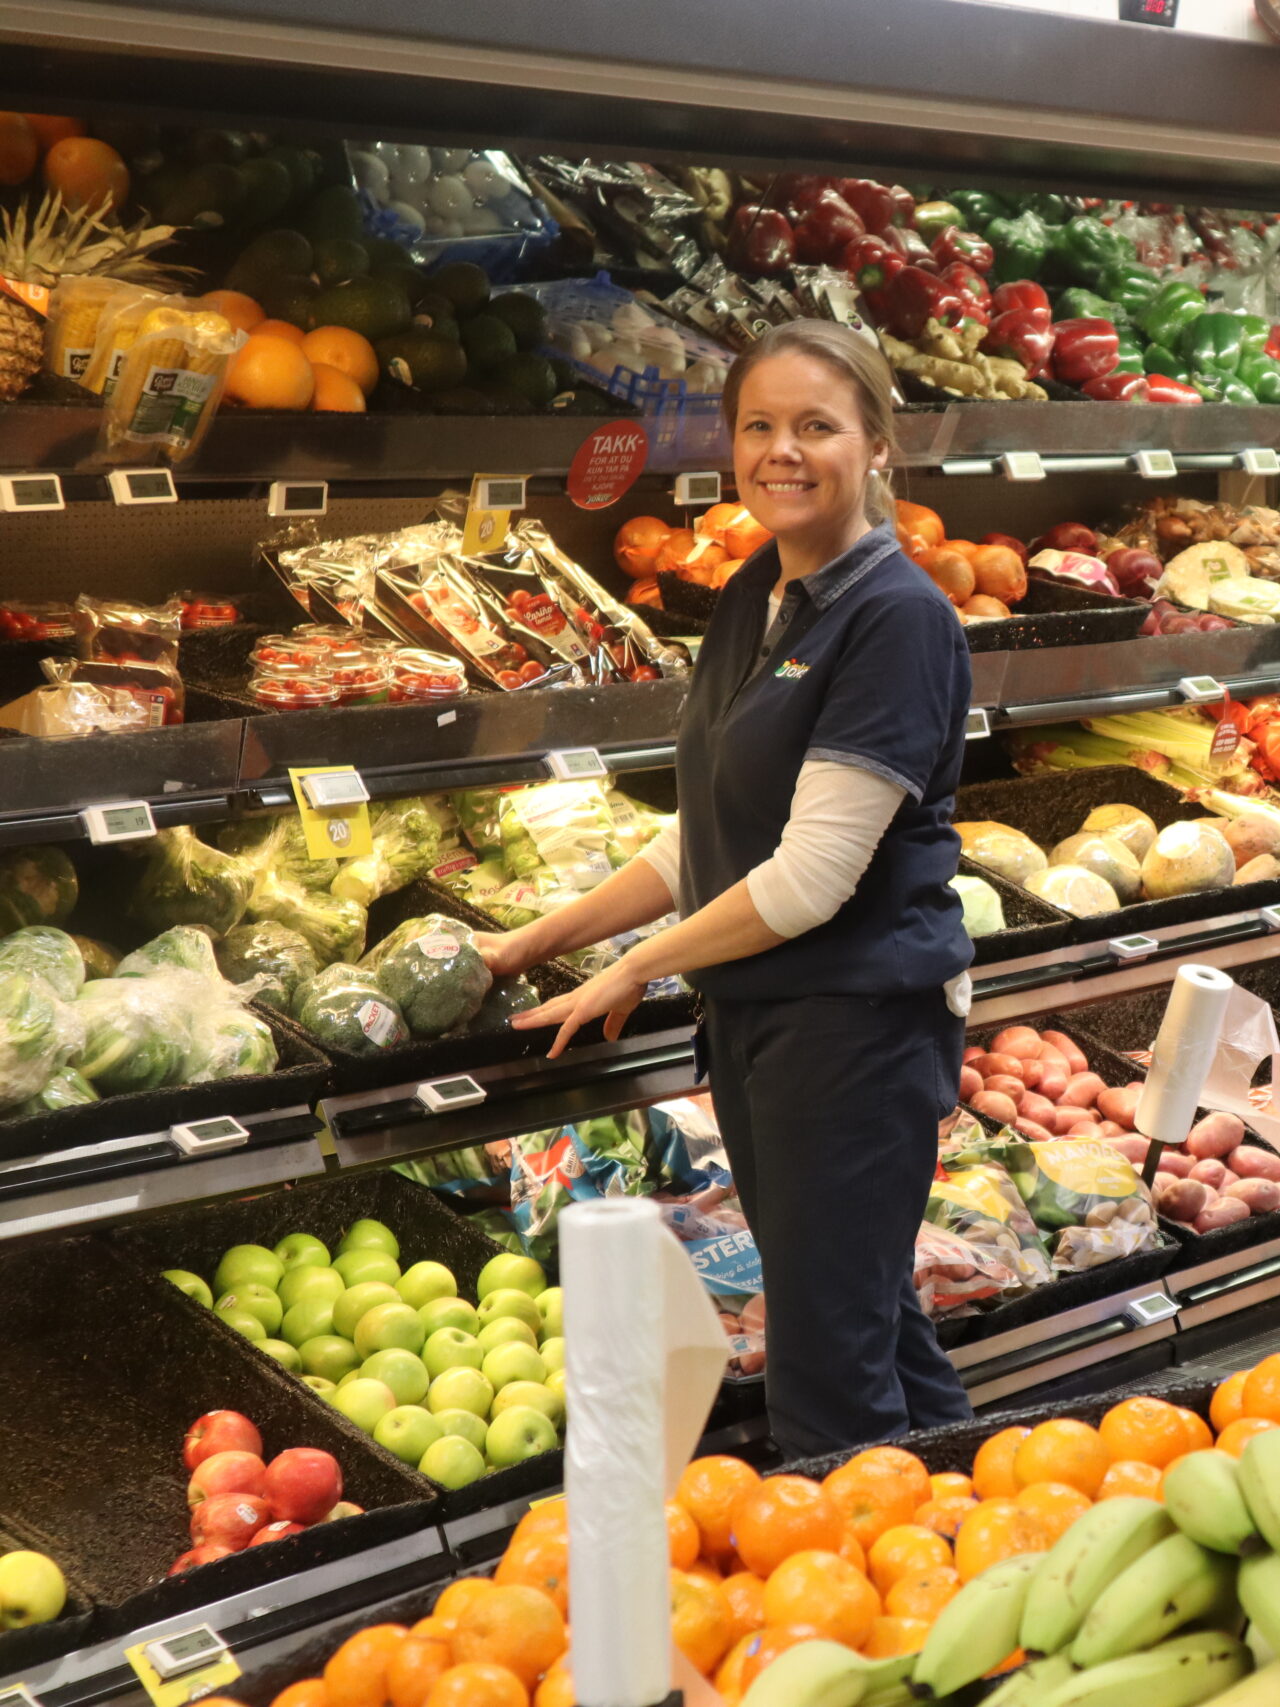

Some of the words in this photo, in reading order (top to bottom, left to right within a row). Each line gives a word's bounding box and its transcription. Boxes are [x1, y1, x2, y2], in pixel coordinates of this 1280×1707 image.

[589, 457, 607, 465] FOR
[609, 456, 619, 465] AT
[620, 455, 632, 464] DU
[329, 822, 347, 842] 20
